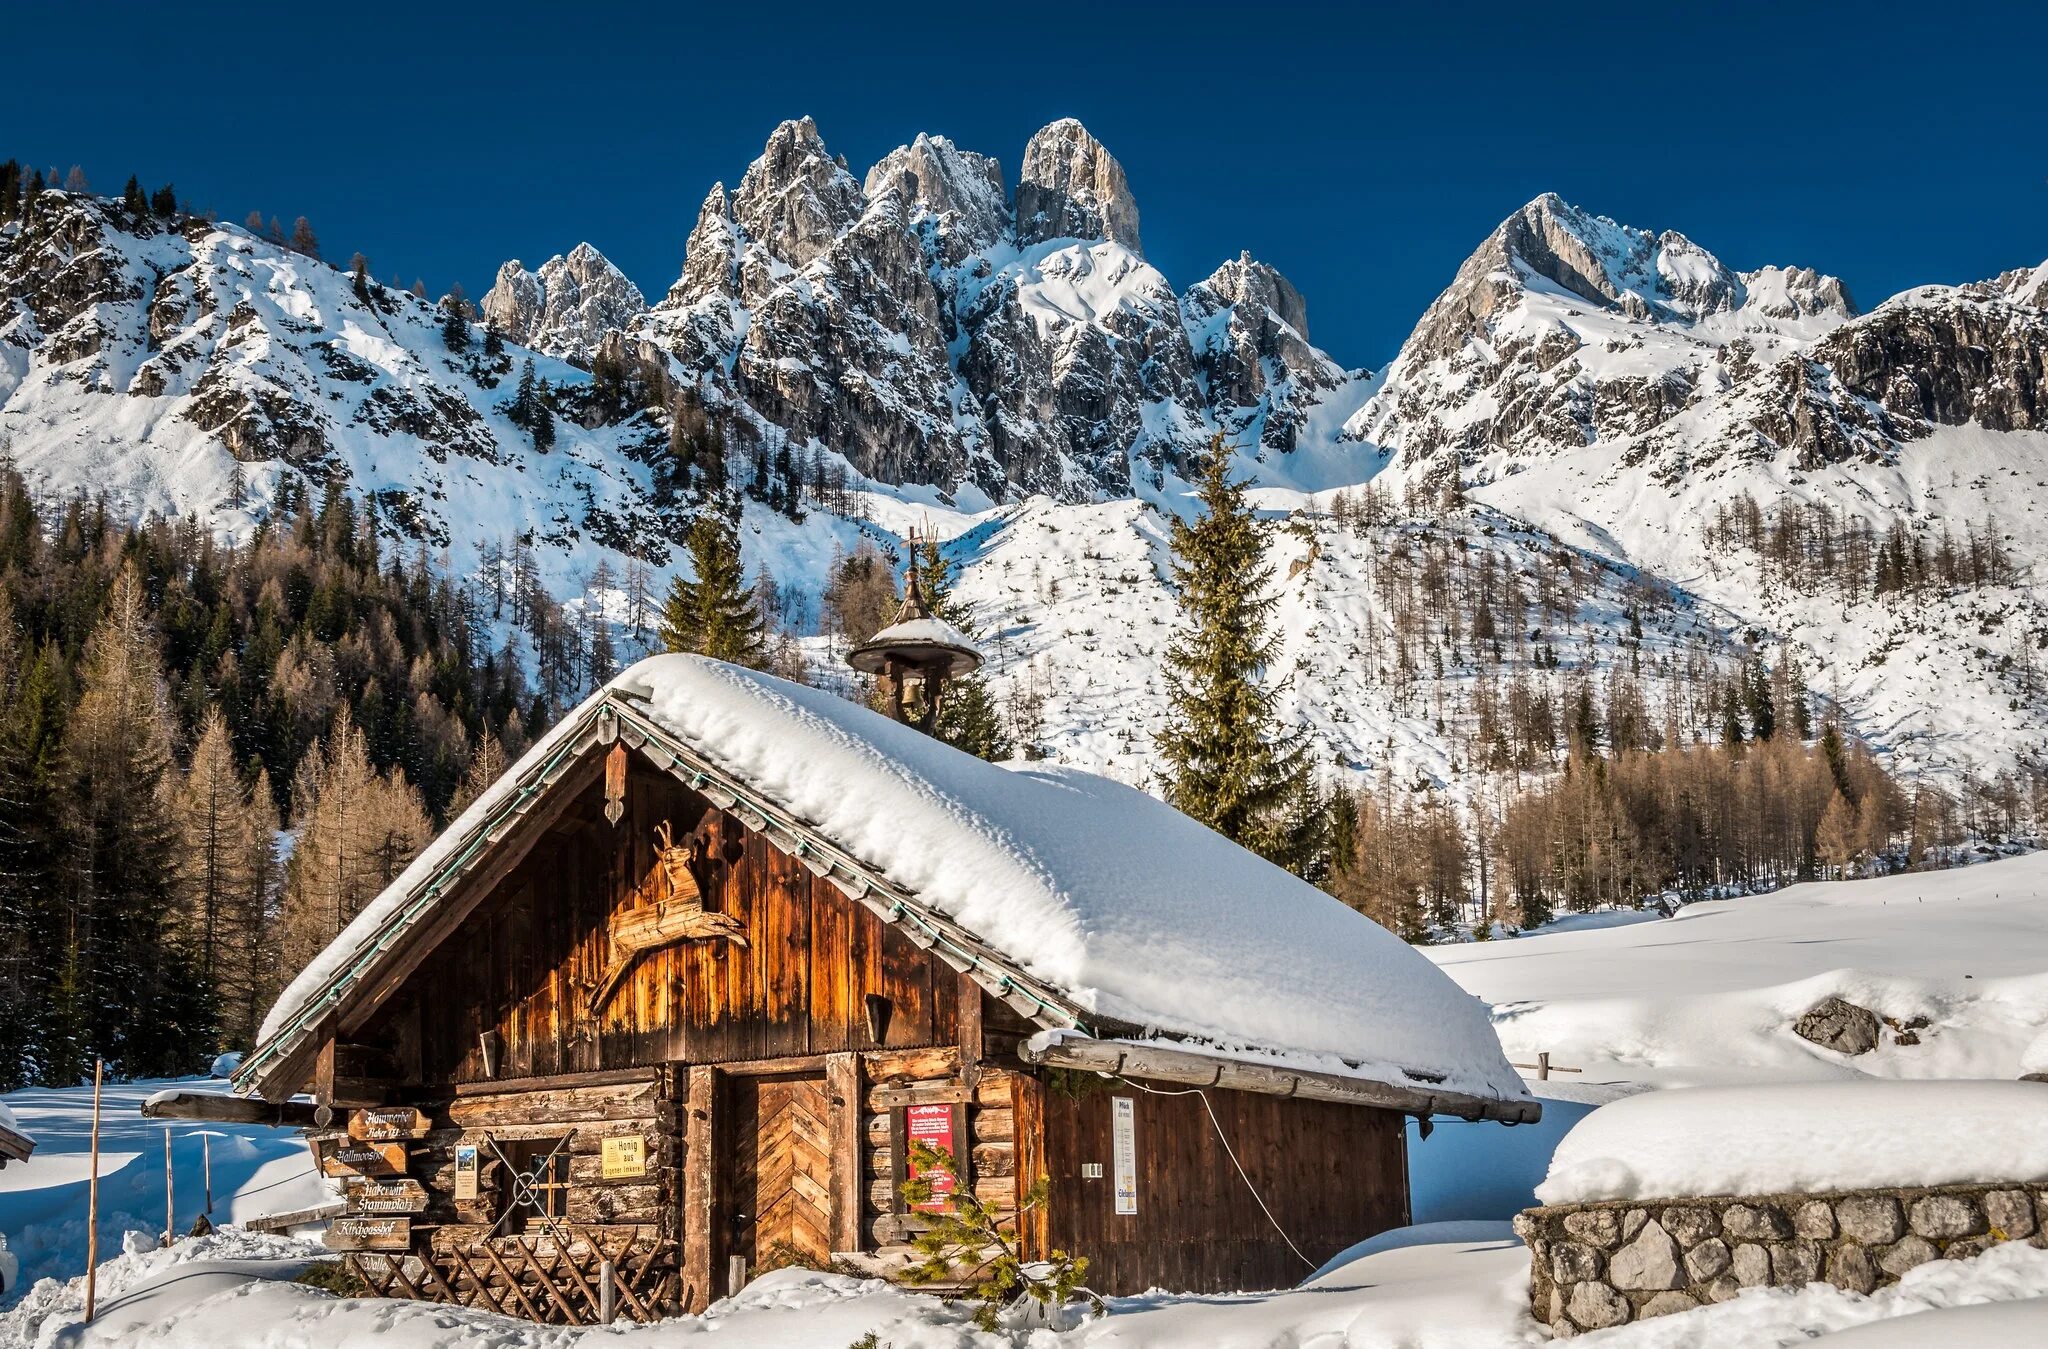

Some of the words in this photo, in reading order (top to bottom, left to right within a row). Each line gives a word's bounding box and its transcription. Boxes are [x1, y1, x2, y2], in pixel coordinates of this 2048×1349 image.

[618, 1139, 638, 1152] Honig
[335, 1148, 386, 1165] Hallmooshof
[623, 1154, 634, 1162] aus
[357, 1197, 413, 1211] Stammplatz
[337, 1221, 396, 1238] Kirchgasshof
